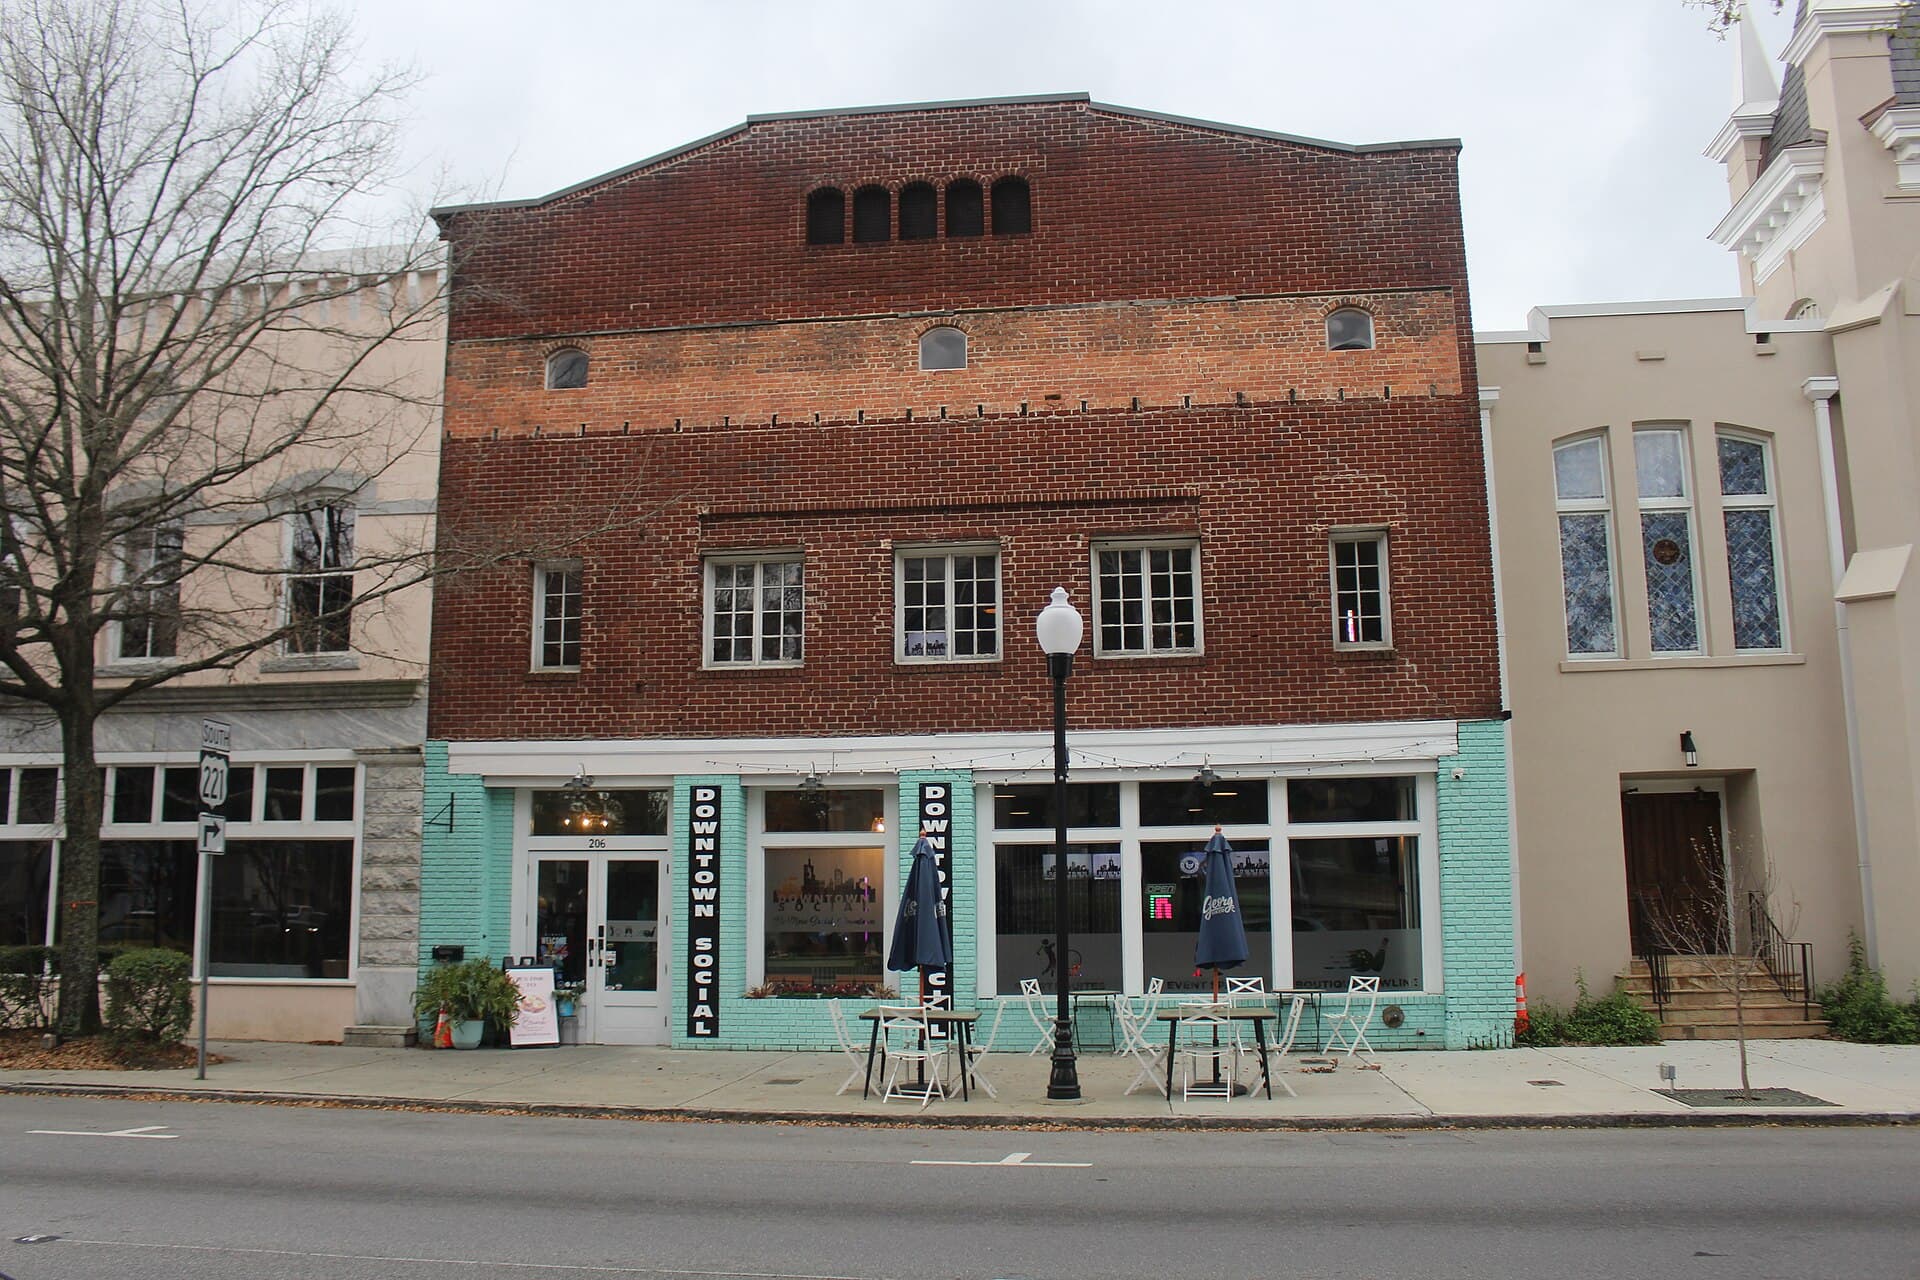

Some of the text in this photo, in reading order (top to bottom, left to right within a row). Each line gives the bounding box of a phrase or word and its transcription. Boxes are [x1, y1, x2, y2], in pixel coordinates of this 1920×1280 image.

[203, 724, 231, 746] SOUTH
[203, 766, 224, 800] 221
[588, 839, 606, 849] 206
[922, 786, 949, 916] DOWNT
[777, 894, 870, 903] DOWNTOWN
[691, 788, 718, 1035] DOWNTOWN SOCIAL
[777, 903, 871, 912] SOCIAL
[1166, 981, 1208, 990] EVENT
[1295, 979, 1347, 989] BOUTIQ
